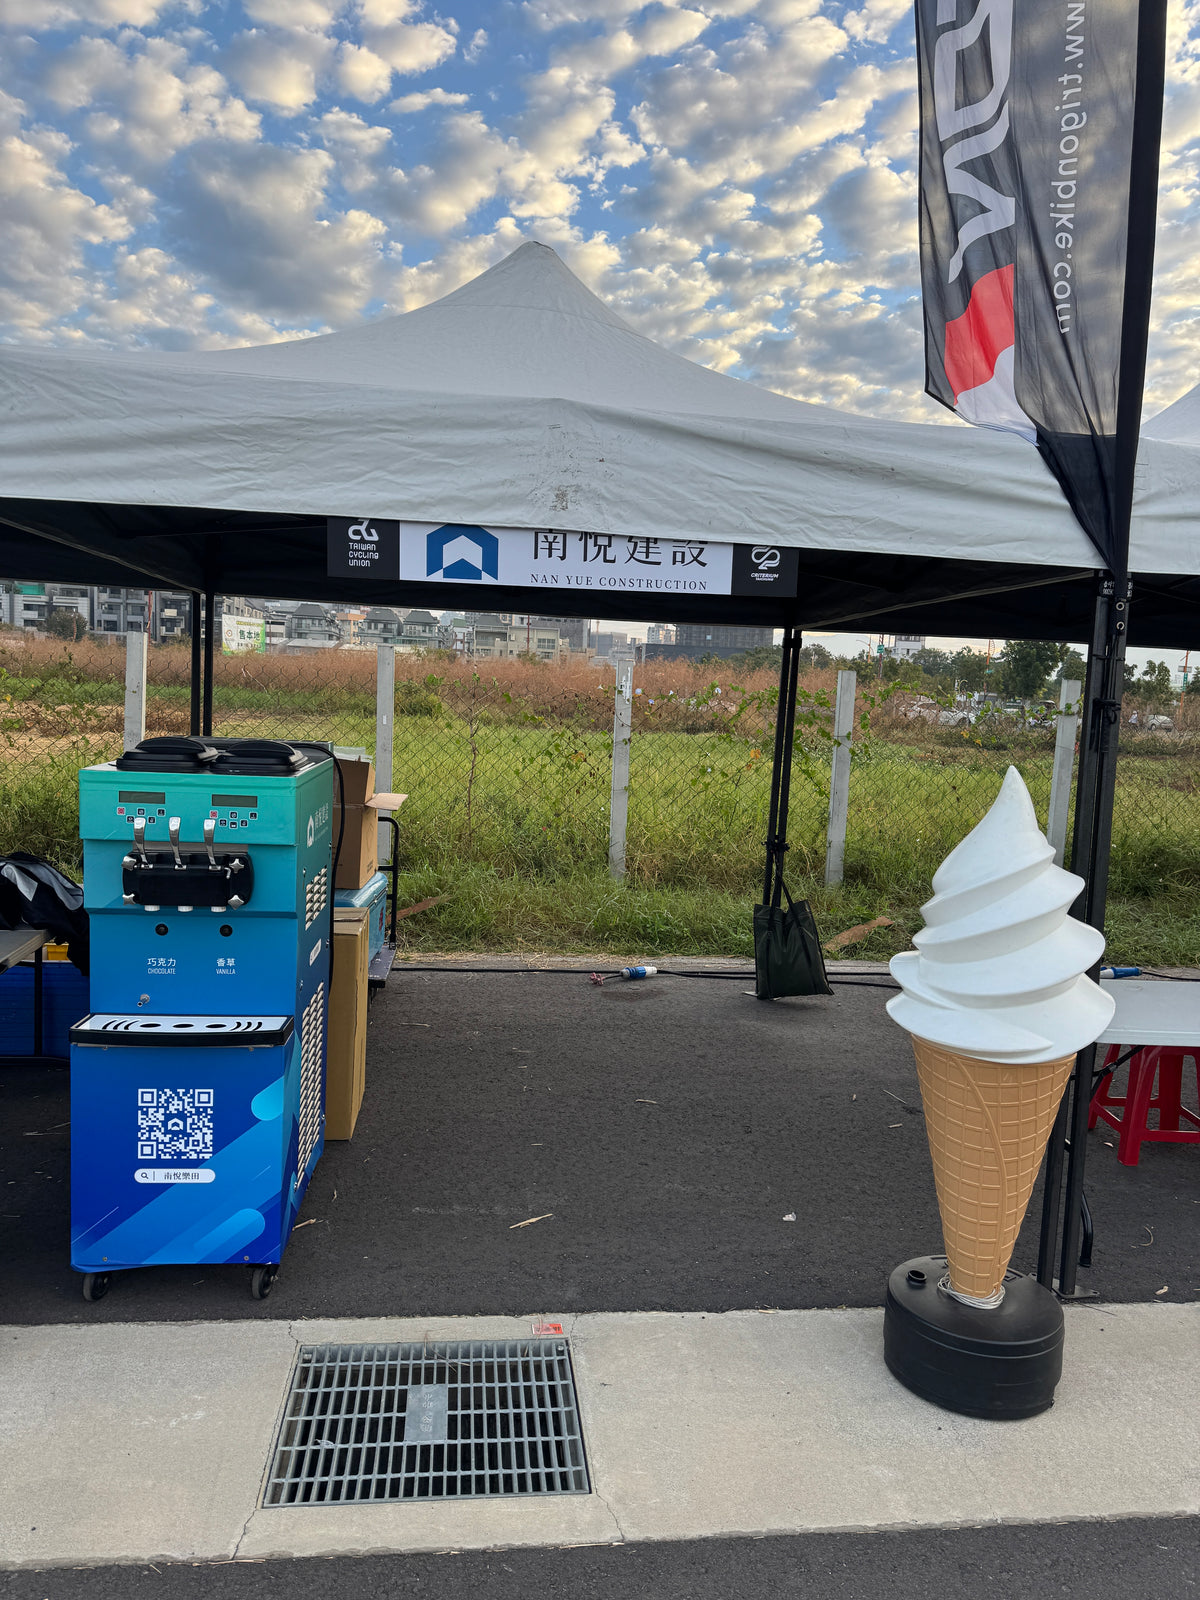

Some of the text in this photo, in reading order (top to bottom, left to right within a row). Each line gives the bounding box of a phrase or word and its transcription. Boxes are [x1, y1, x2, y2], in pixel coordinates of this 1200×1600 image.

[533, 528, 709, 568] 南悅建設
[530, 573, 708, 591] NAN YUE CONSTRUCTION
[147, 957, 176, 967] 巧克力
[216, 957, 236, 967] 香草
[147, 967, 176, 975] CHOCOLATE
